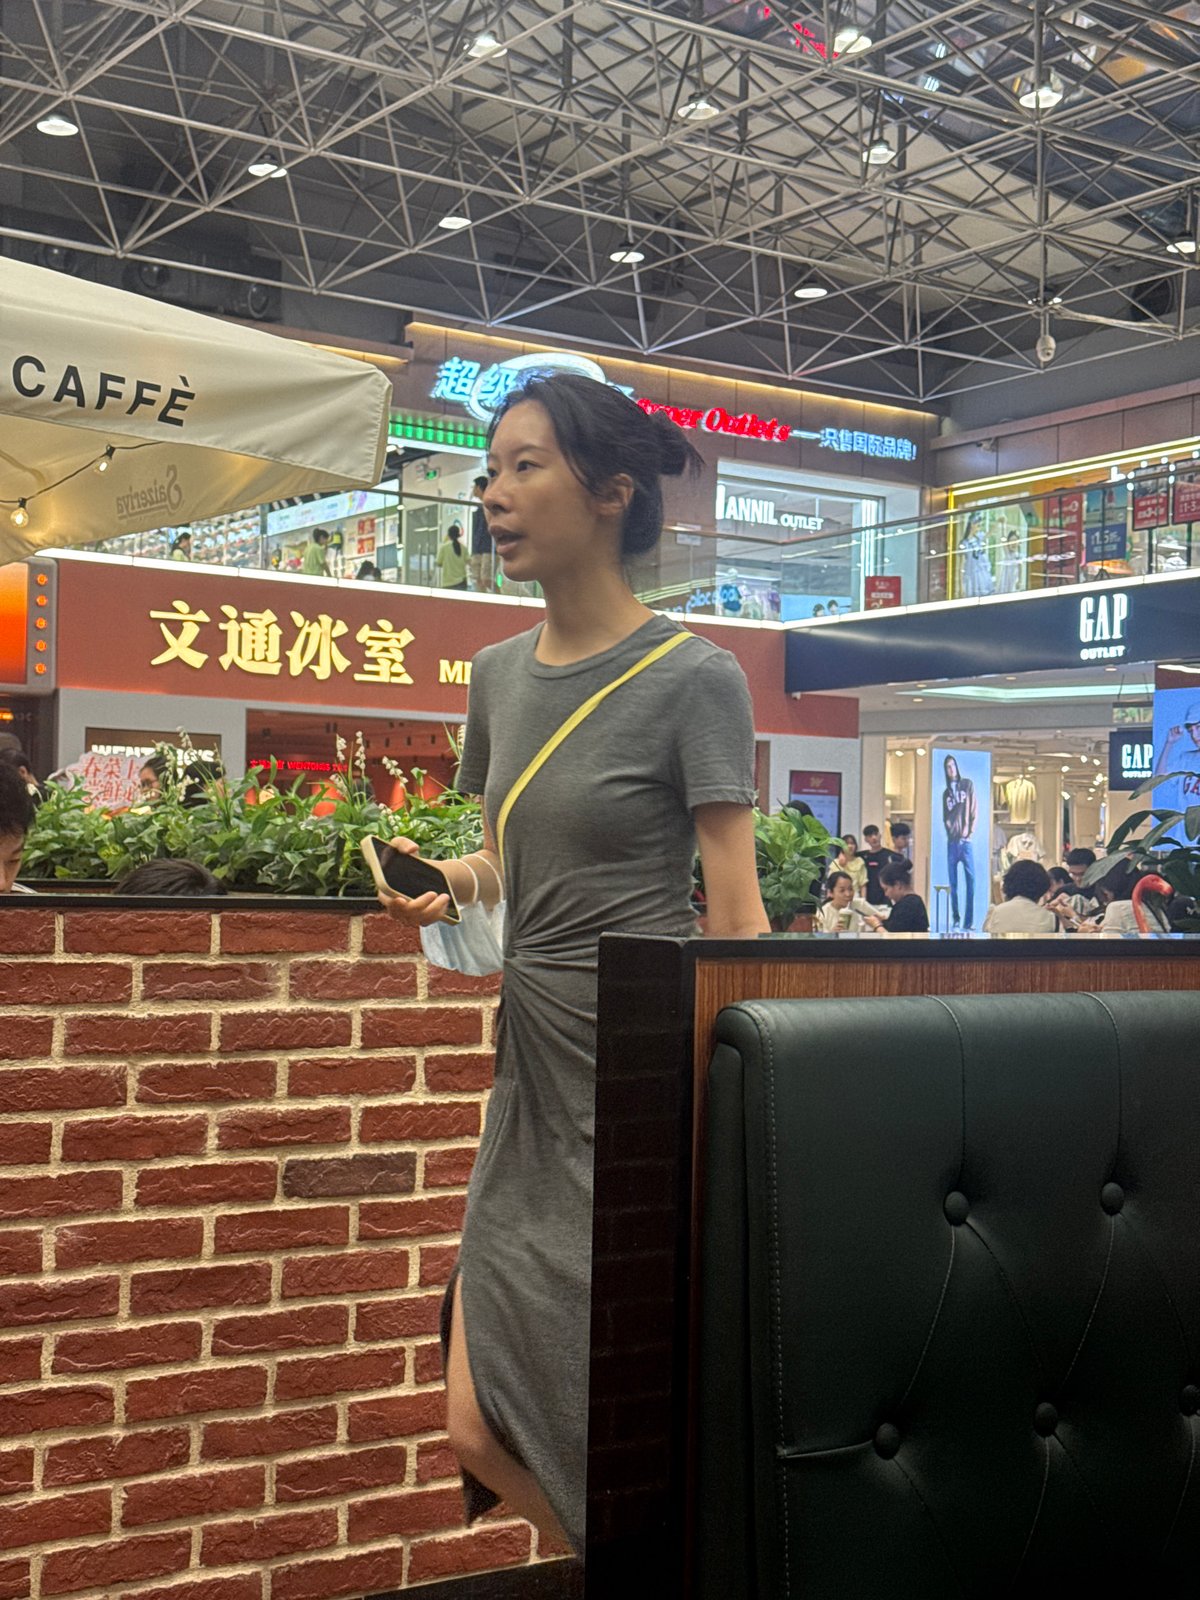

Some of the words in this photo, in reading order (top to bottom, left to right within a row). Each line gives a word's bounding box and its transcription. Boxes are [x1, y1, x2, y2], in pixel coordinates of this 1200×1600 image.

[12, 355, 196, 427] CAFFÈ
[702, 407, 791, 442] Outlets
[725, 496, 778, 525] ANNIL
[780, 513, 825, 531] OUTLET
[1079, 593, 1128, 643] GAP
[149, 599, 416, 685] 文通冰室
[1080, 645, 1126, 661] OUTLET
[1121, 743, 1154, 769] GAP
